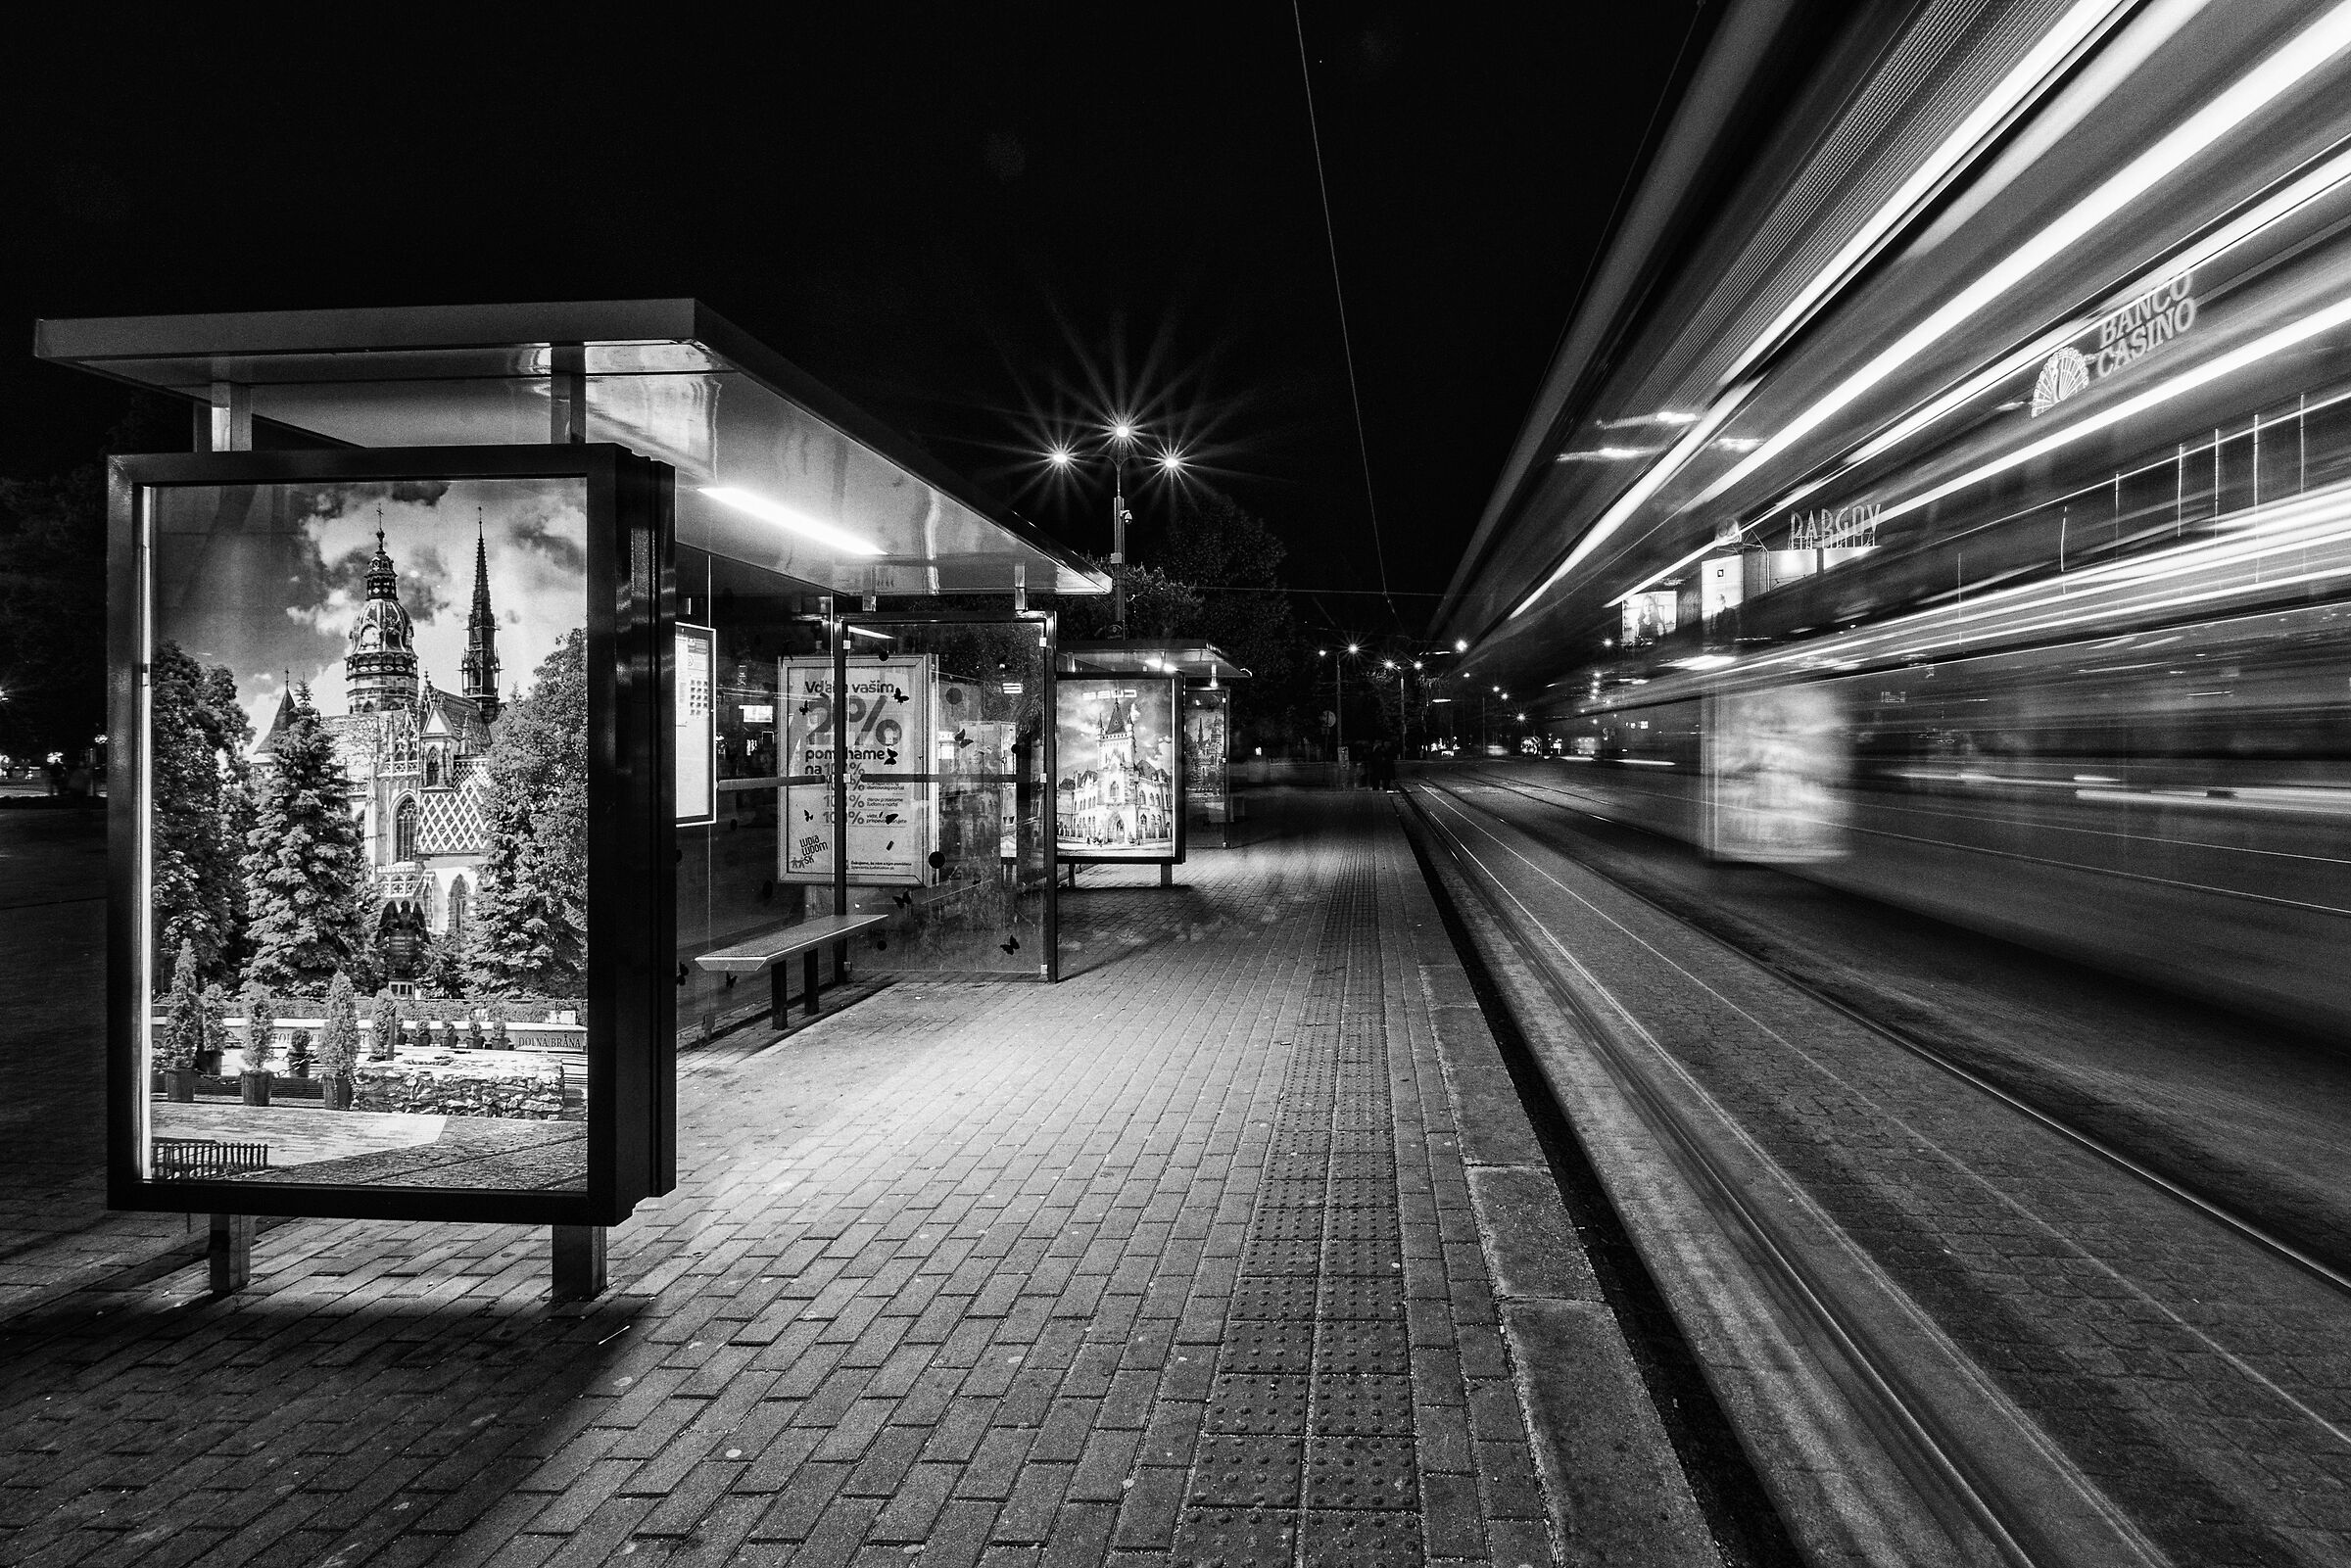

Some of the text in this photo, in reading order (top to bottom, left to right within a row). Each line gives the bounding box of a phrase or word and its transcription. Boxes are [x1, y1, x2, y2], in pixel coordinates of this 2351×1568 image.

[2099, 272, 2193, 349] BANCO
[2097, 298, 2197, 378] CASINO
[1791, 503, 1881, 540] DARGOV
[805, 680, 848, 693] Vďa
[805, 747, 886, 762] pomhame
[804, 765, 823, 775] na
[823, 794, 865, 808] 10%
[823, 811, 865, 825] 10%
